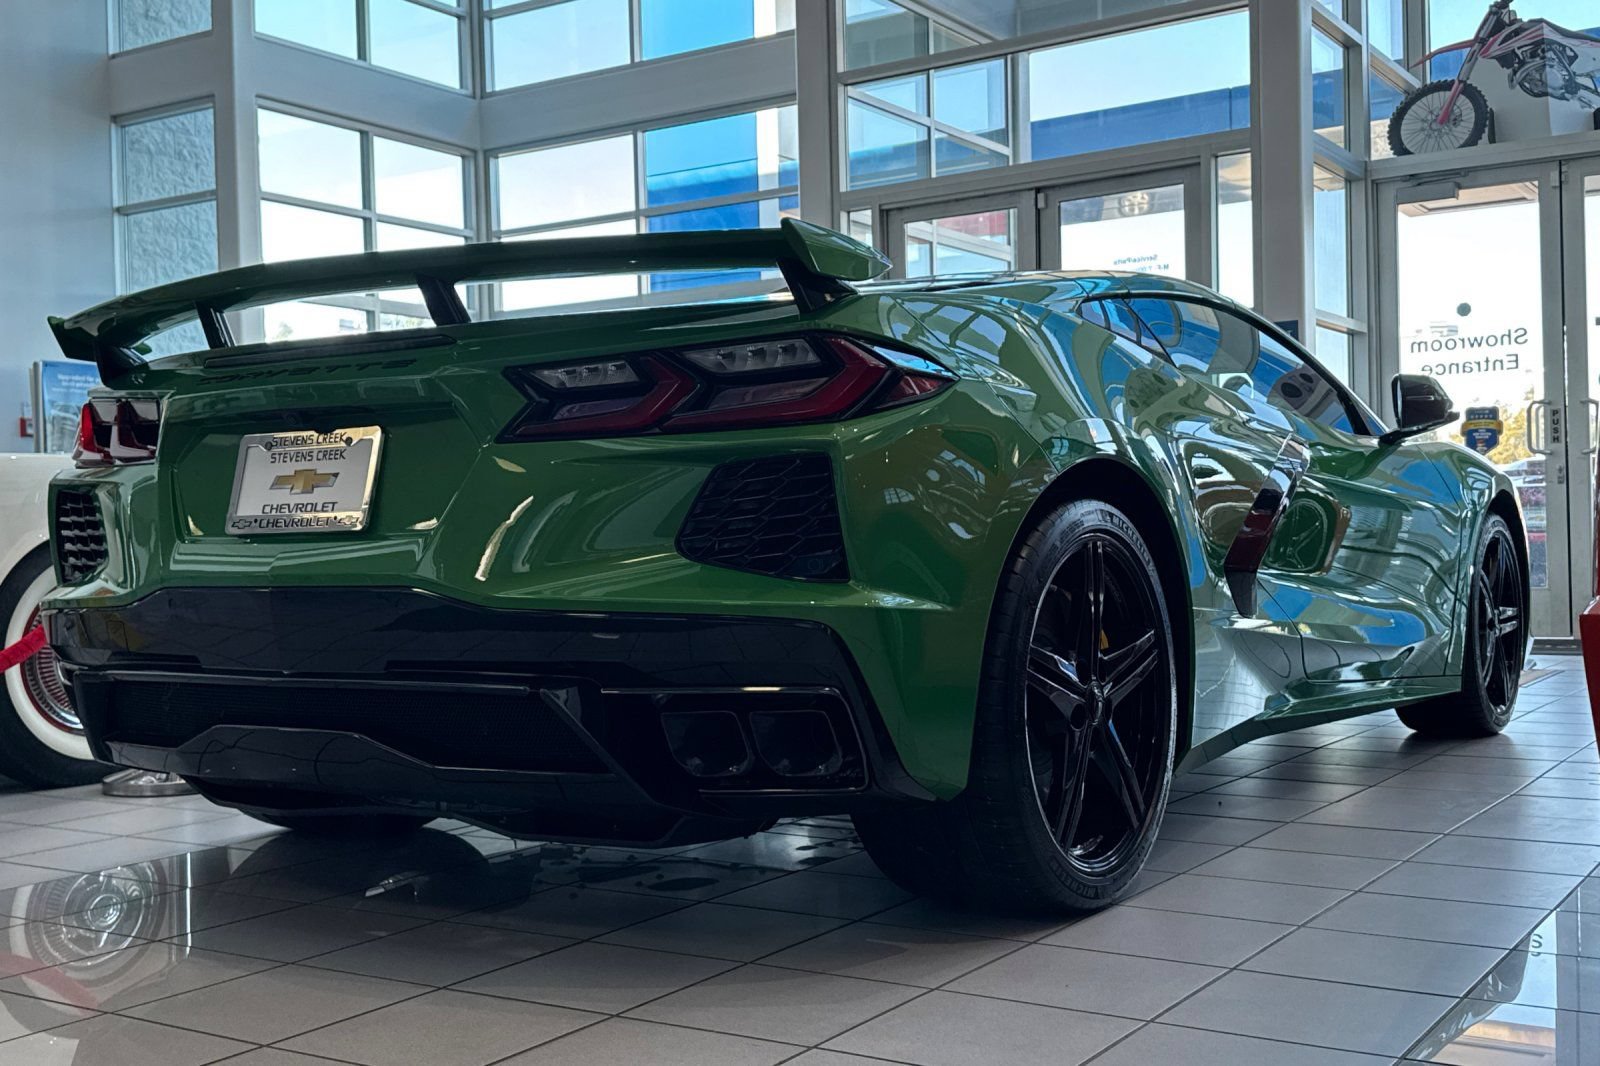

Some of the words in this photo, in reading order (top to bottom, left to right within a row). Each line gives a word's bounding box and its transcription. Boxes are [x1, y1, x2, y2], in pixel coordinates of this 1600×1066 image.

[1552, 410, 1560, 443] PUSH
[271, 435, 314, 448] STEVENS
[316, 432, 347, 445] CREEK
[270, 450, 314, 463] STEVENS
[316, 449, 346, 461] CREEK
[261, 501, 338, 514] CHEVROLET
[258, 517, 331, 529] CHEVROLET
[1112, 515, 1150, 563] MICHELIN
